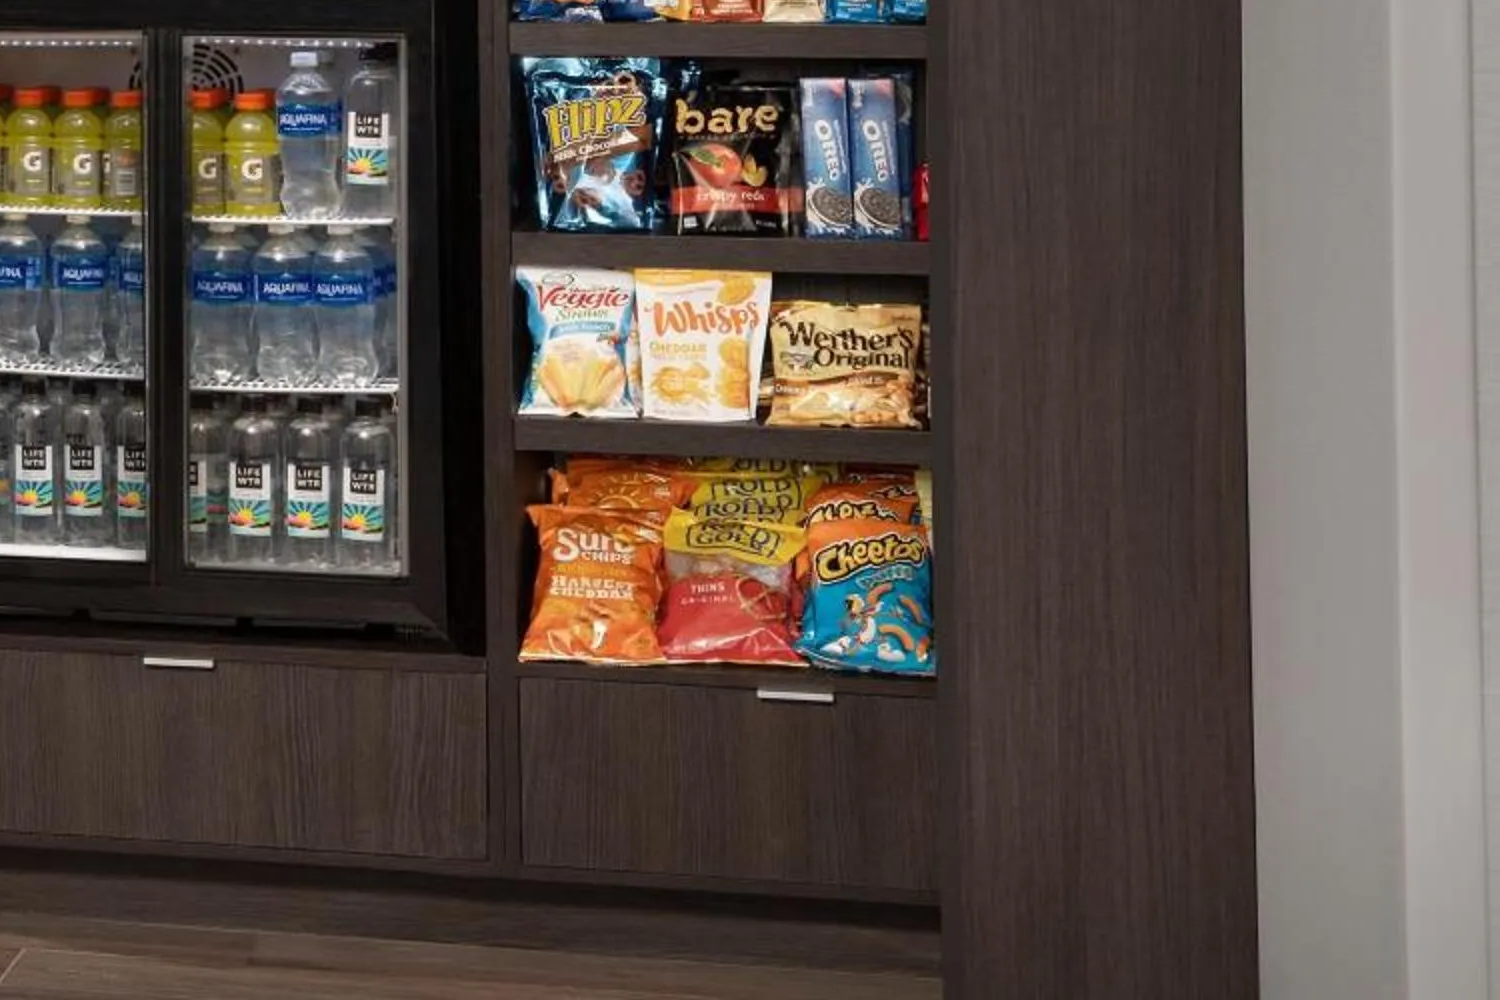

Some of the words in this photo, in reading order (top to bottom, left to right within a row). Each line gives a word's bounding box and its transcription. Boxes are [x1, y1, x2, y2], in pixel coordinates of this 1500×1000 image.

[280, 114, 327, 127] AQUAFINA
[674, 99, 780, 135] bare
[813, 118, 840, 182] OREO
[862, 118, 890, 182] OREO
[23, 151, 42, 172] G
[73, 152, 92, 175] G
[199, 158, 217, 179] G
[241, 158, 263, 180] G
[537, 284, 630, 312] Veggie
[652, 300, 761, 337] Whisps
[779, 321, 914, 351] Werther's
[814, 347, 911, 371] Original
[238, 467, 261, 477] LIFE
[238, 477, 261, 486] WTR
[298, 469, 321, 478] LIFE
[352, 473, 375, 482] LIFE
[298, 479, 321, 488] WTR
[352, 482, 375, 491] WTR
[581, 551, 633, 565] CHIPS
[817, 533, 925, 580] Cheetos
[551, 575, 635, 591] HARVEST
[551, 587, 634, 600] CHEDDAR
[691, 581, 726, 594] THINS
